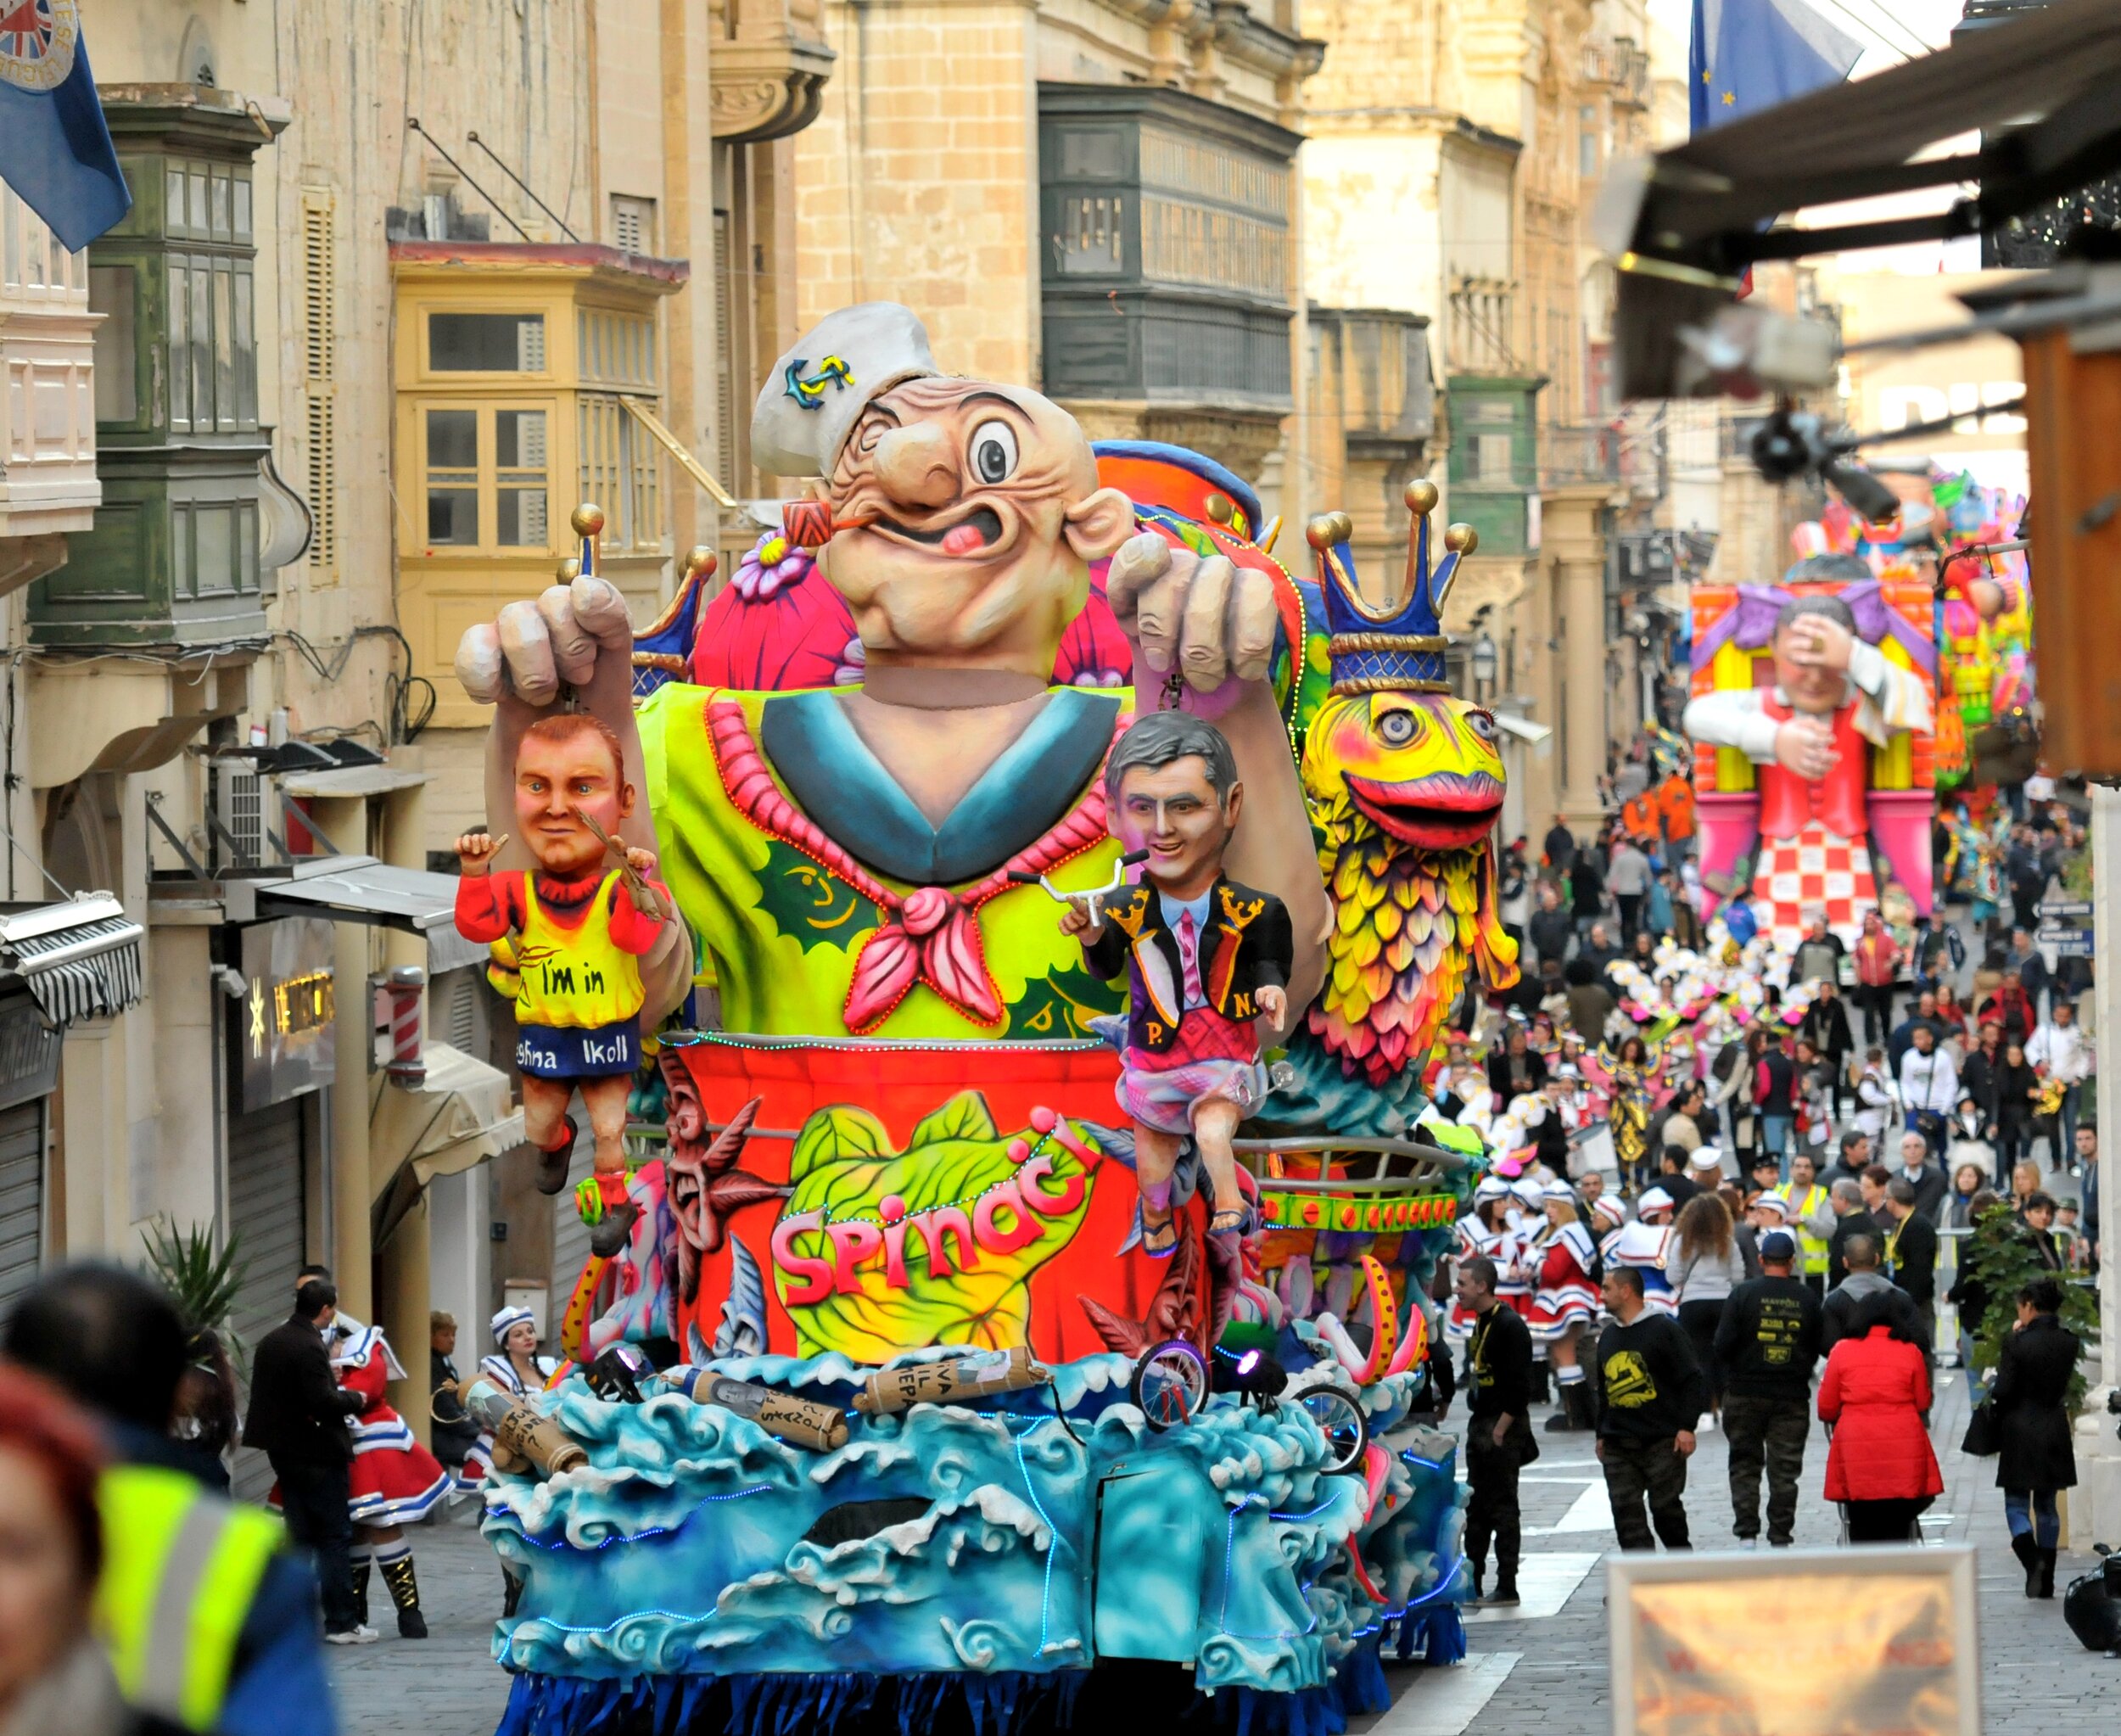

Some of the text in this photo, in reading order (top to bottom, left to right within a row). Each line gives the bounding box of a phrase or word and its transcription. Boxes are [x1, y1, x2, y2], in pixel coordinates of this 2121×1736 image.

[584, 961, 604, 994] in
[1234, 993, 1256, 1017] N.
[1146, 1022, 1162, 1044] P.
[917, 1369, 931, 1389] IL
